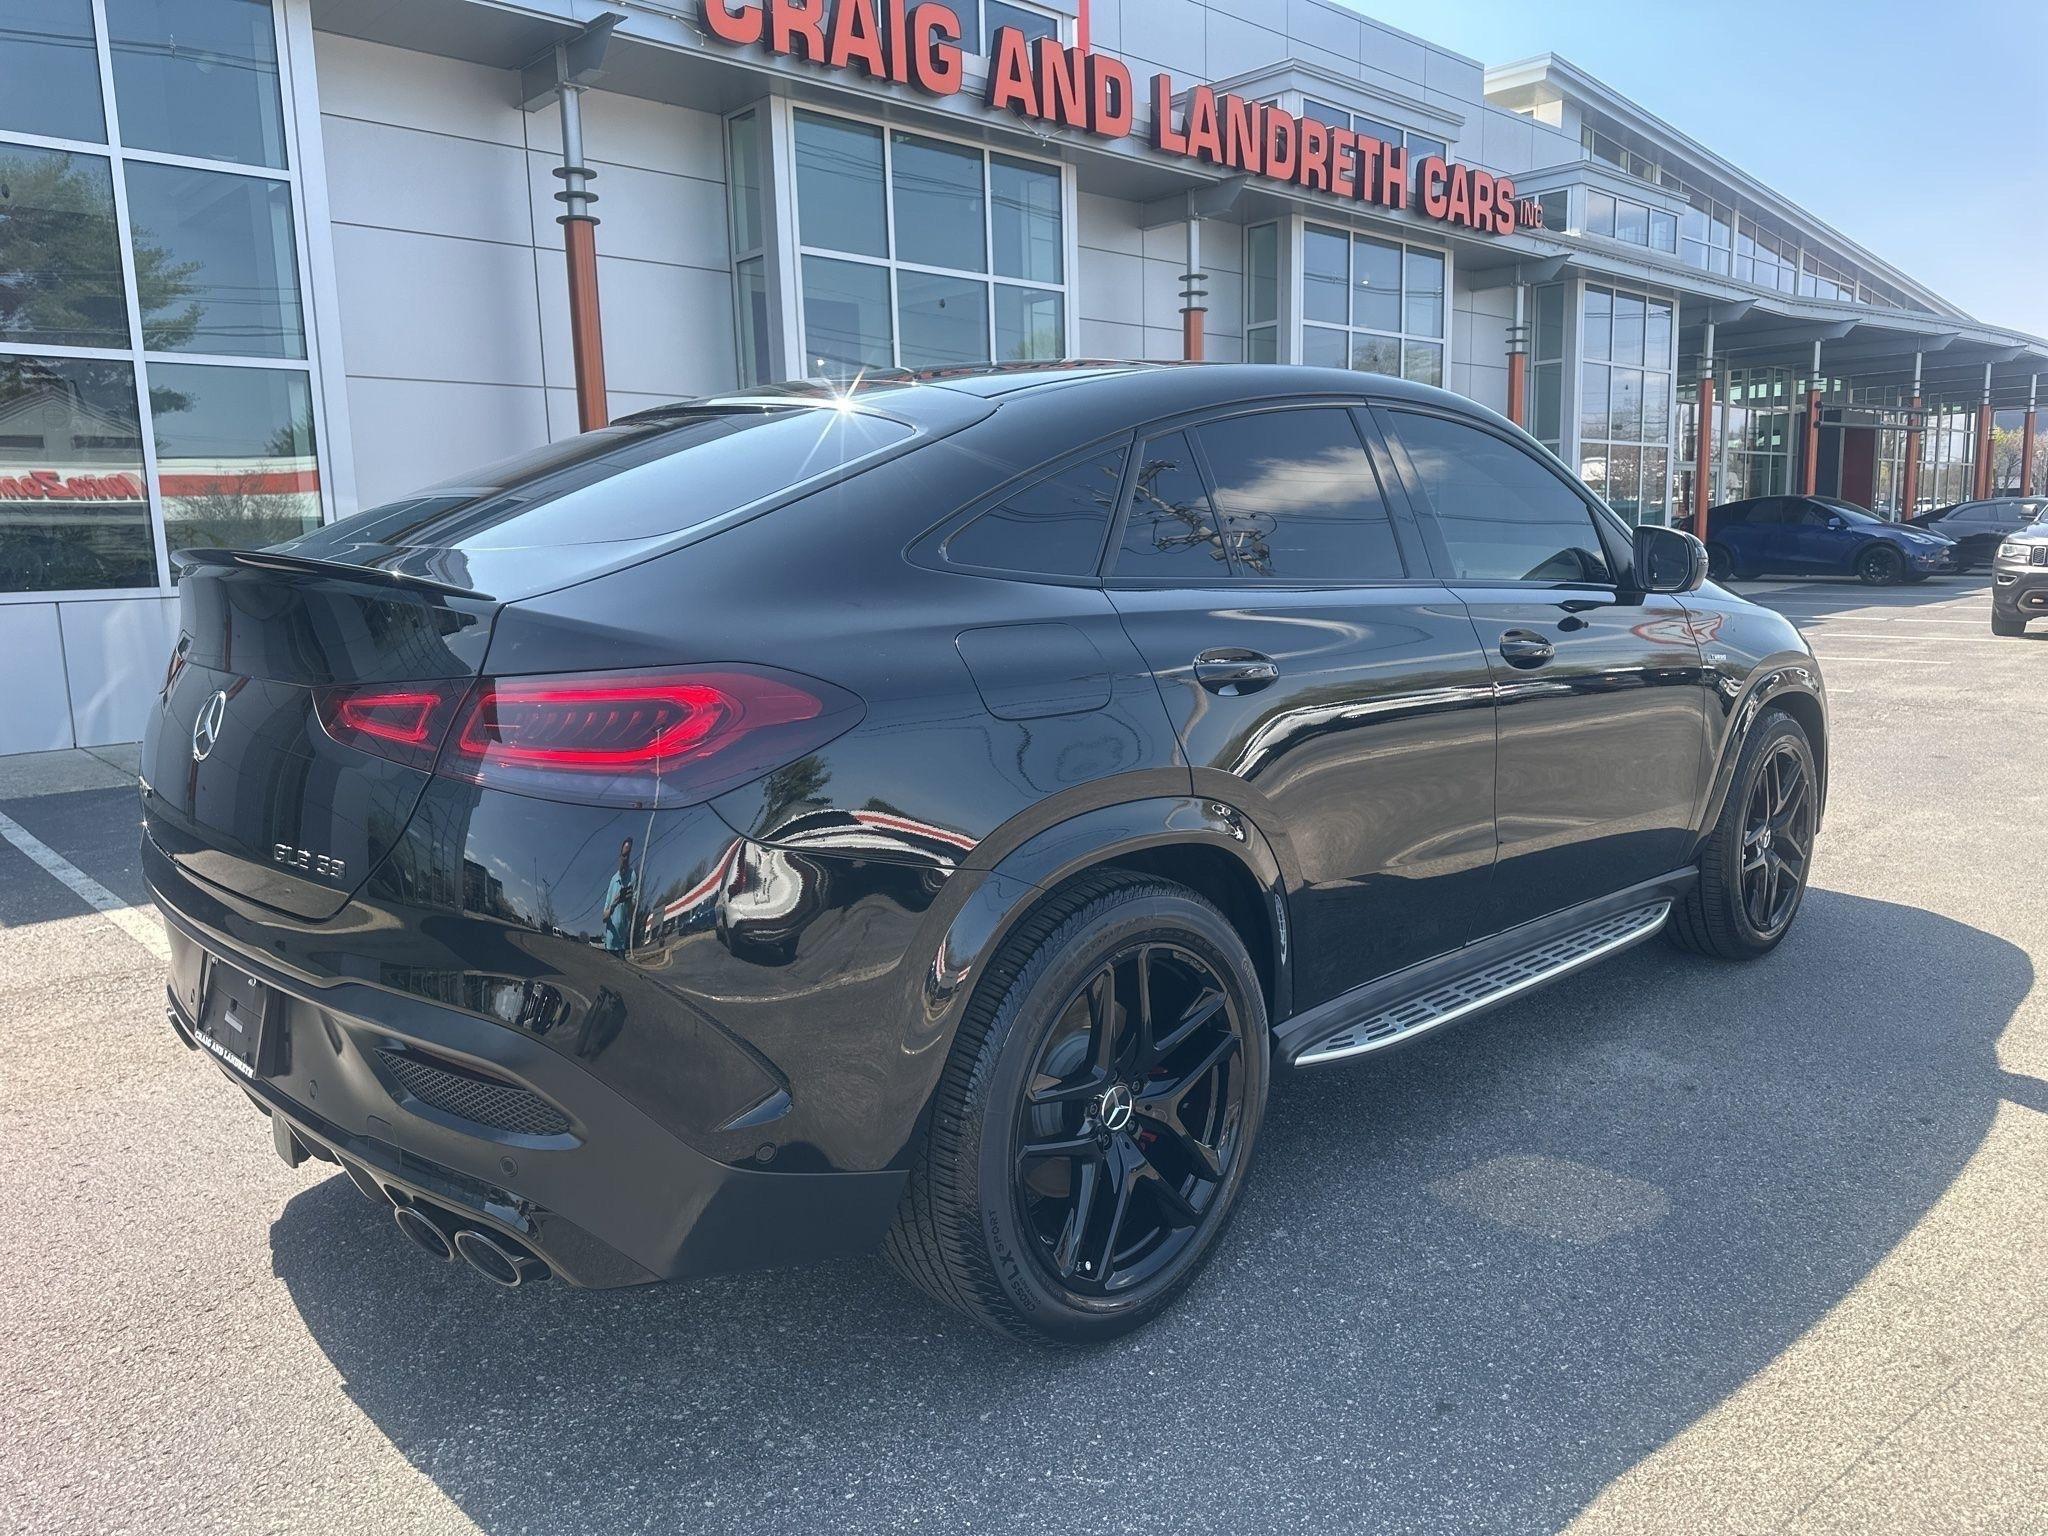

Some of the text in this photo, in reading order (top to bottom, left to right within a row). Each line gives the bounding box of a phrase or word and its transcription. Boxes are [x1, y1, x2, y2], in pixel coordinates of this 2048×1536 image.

[702, 0, 1544, 235] CRAIG AND LANDRETH CARS INC
[273, 843, 311, 870] GLE
[194, 1030, 212, 1048] CRAIG
[211, 1042, 224, 1057] AND
[999, 1250, 1020, 1281] LX
